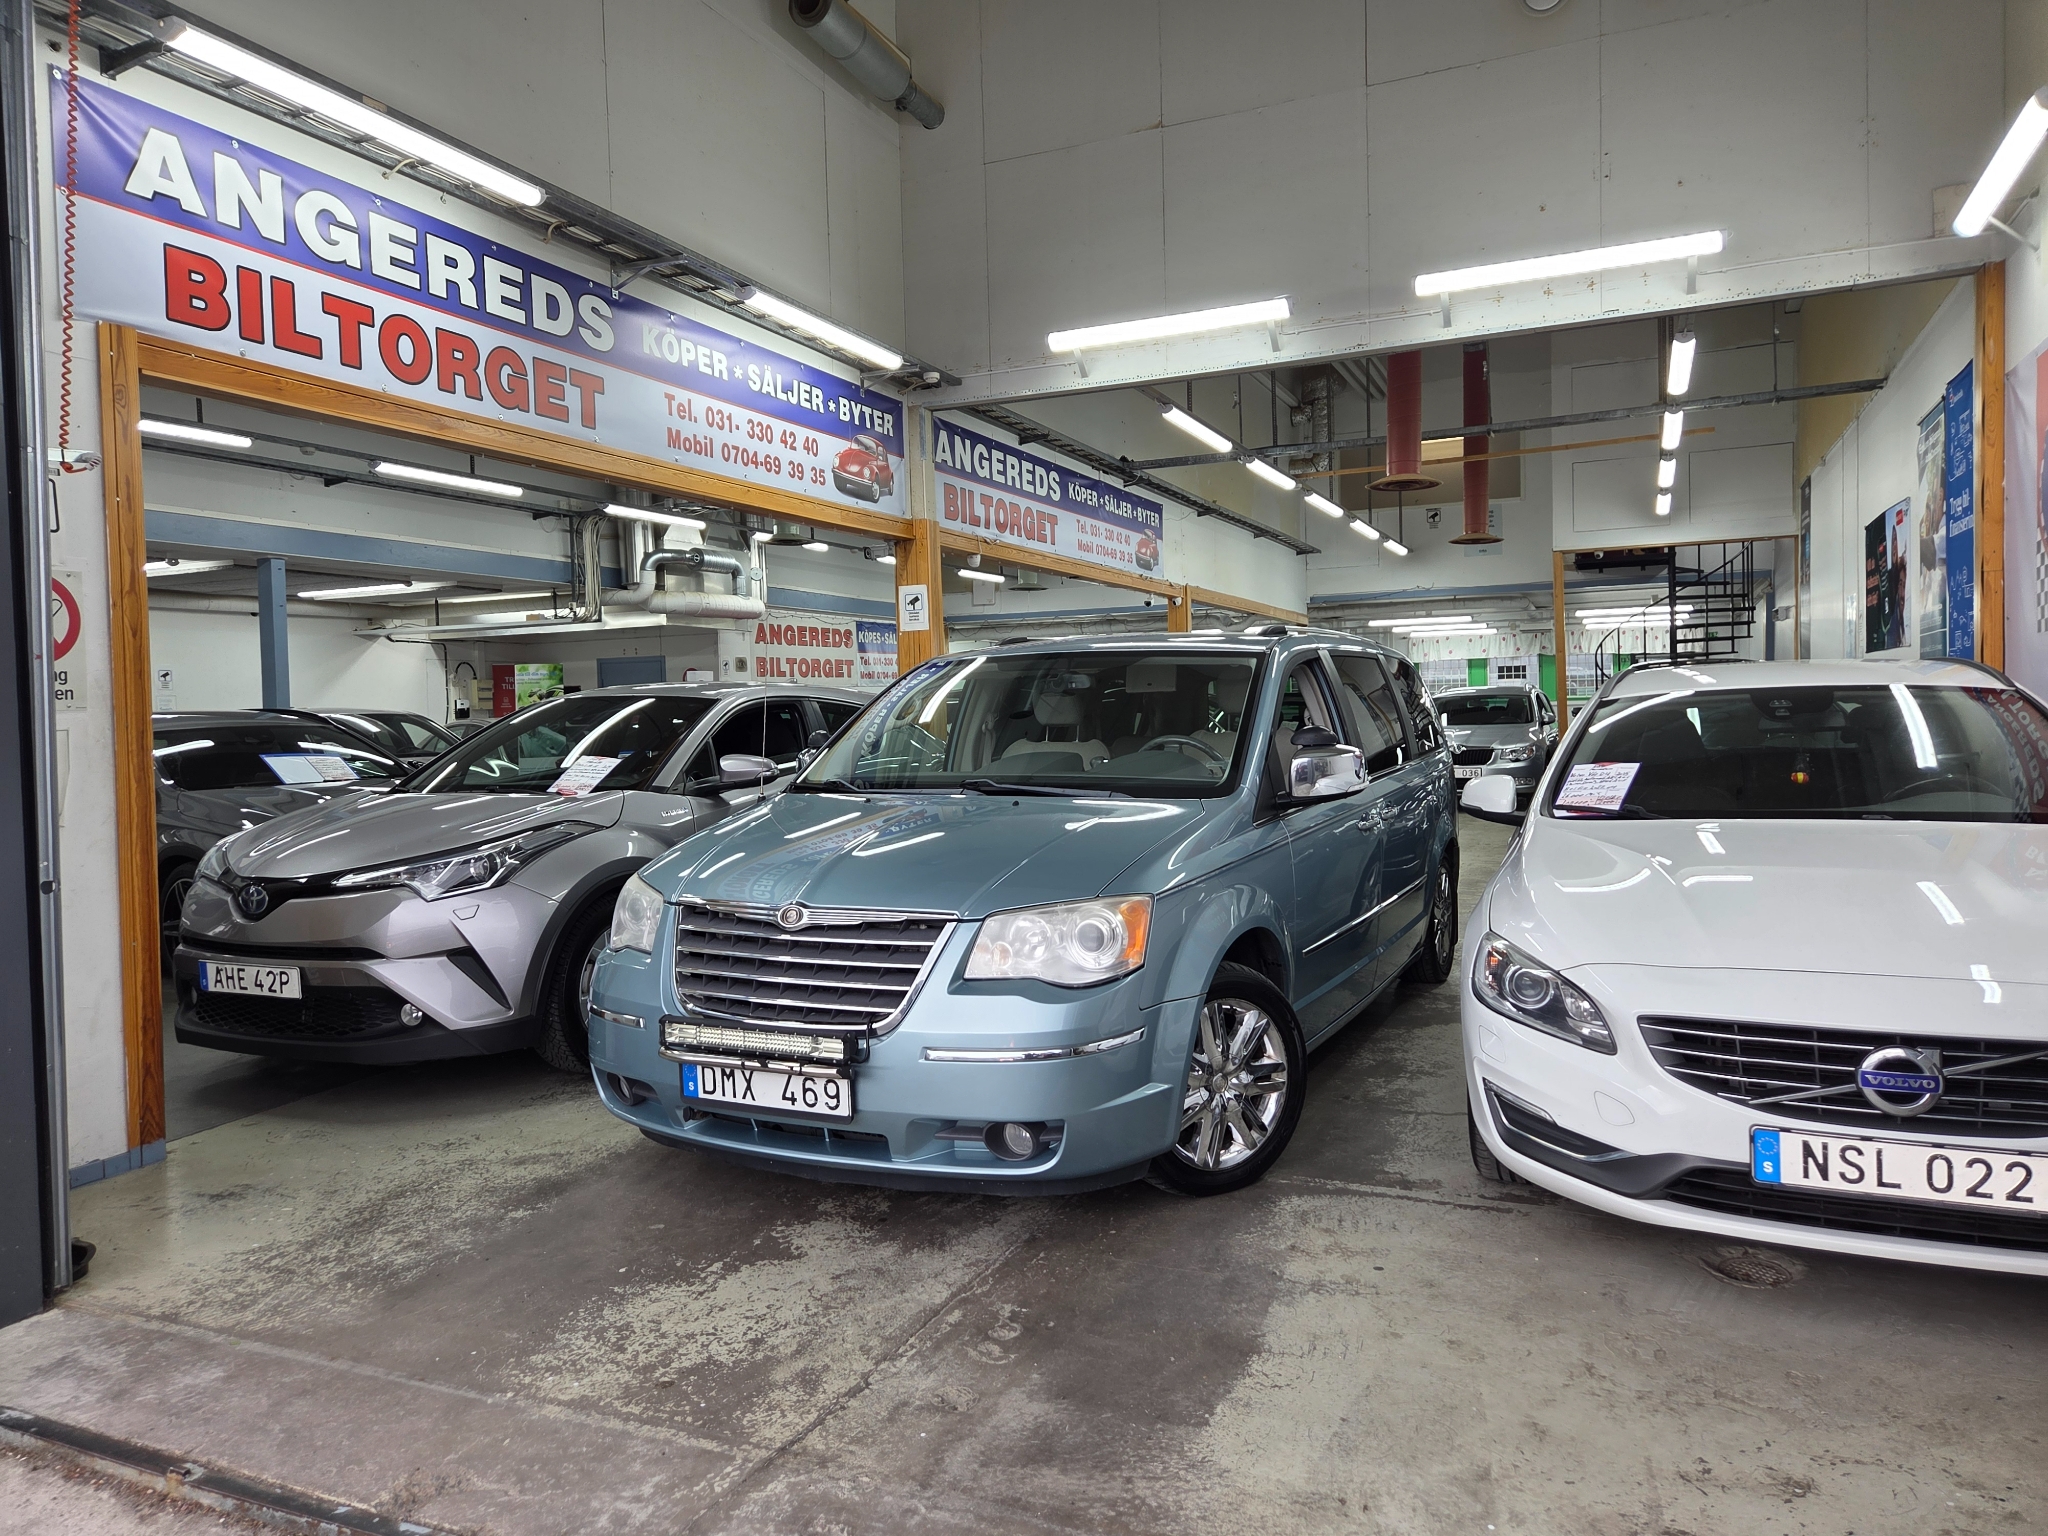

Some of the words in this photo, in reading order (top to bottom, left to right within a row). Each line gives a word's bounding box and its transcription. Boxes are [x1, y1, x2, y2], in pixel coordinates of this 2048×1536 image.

[124, 127, 615, 353] ANGEREDS
[163, 242, 605, 430] BILTORGET
[642, 323, 729, 381] KÖPER
[747, 365, 825, 414] SÄLJER
[838, 396, 894, 437] BYTER
[664, 392, 698, 424] Tel.
[746, 418, 774, 445] 330
[779, 428, 797, 452] 42
[802, 435, 819, 457] 40
[666, 426, 714, 459] Mobil
[721, 443, 782, 475] 0704-69
[787, 460, 805, 481] 39
[810, 466, 827, 486] 35
[935, 429, 1061, 502] ANGEREDS
[943, 482, 1059, 546] BILTORGET
[1068, 482, 1099, 508] KÖPER
[1104, 494, 1133, 519] SÄLJER
[1137, 506, 1160, 528] BYTER
[1076, 518, 1089, 535] Tel.
[1104, 527, 1115, 542] 330
[1116, 532, 1123, 545] 42
[1124, 534, 1131, 547] 40
[1077, 538, 1094, 555] Mobil
[754, 622, 854, 649] ANGEREDS
[755, 656, 855, 679] BILTORGET
[1462, 769, 1479, 777] 036
[214, 965, 248, 990] AHE
[254, 969, 290, 994] 42P
[688, 1081, 695, 1091] S
[702, 1065, 756, 1102] DMX
[781, 1074, 841, 1111] 469
[1865, 1074, 1936, 1090] VOLVO
[1763, 1161, 1773, 1174] S
[1802, 1139, 1902, 1190] NSL
[1925, 1153, 2034, 1204] 022
